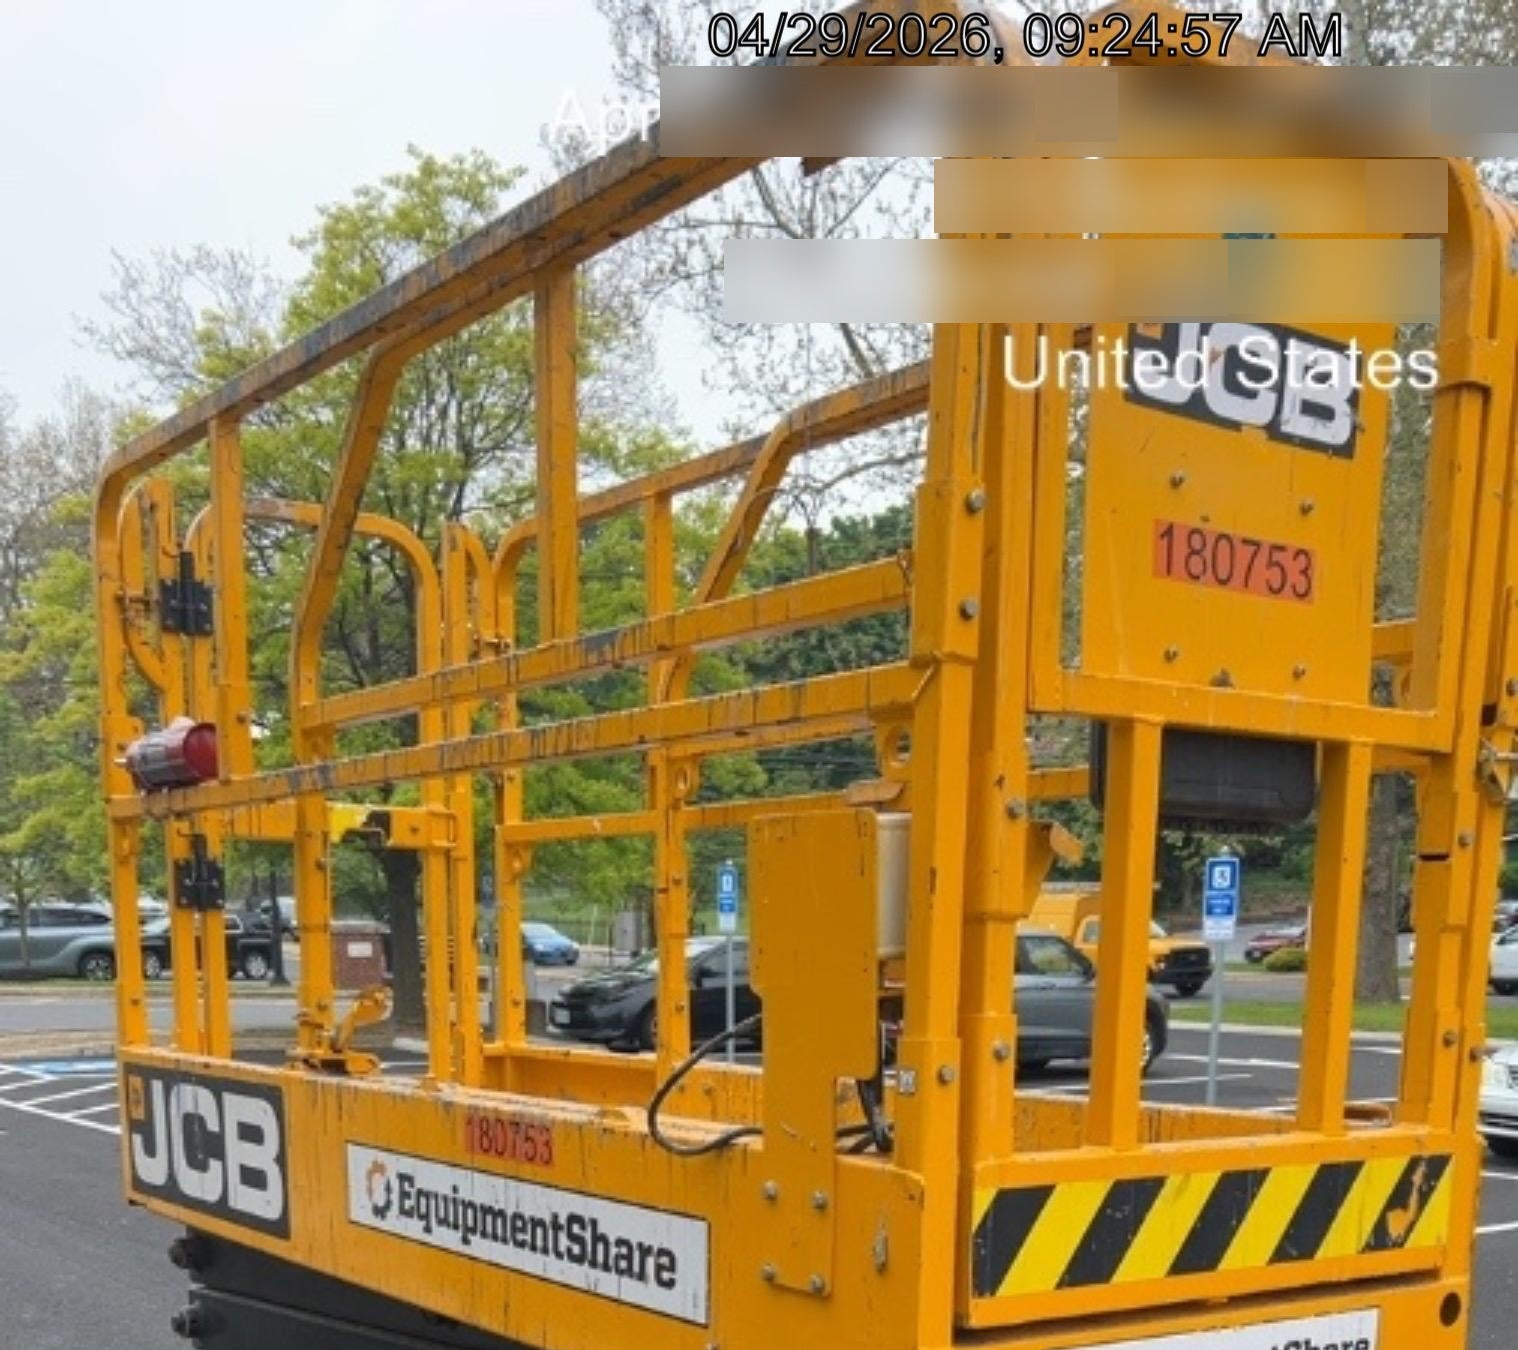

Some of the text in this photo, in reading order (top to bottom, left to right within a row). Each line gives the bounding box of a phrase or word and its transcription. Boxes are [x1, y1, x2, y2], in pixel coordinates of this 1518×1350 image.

[1159, 521, 1314, 600] 180753
[131, 1078, 285, 1222] JCB
[465, 1114, 553, 1165] 180753
[396, 1171, 677, 1290] EquipmentShare
